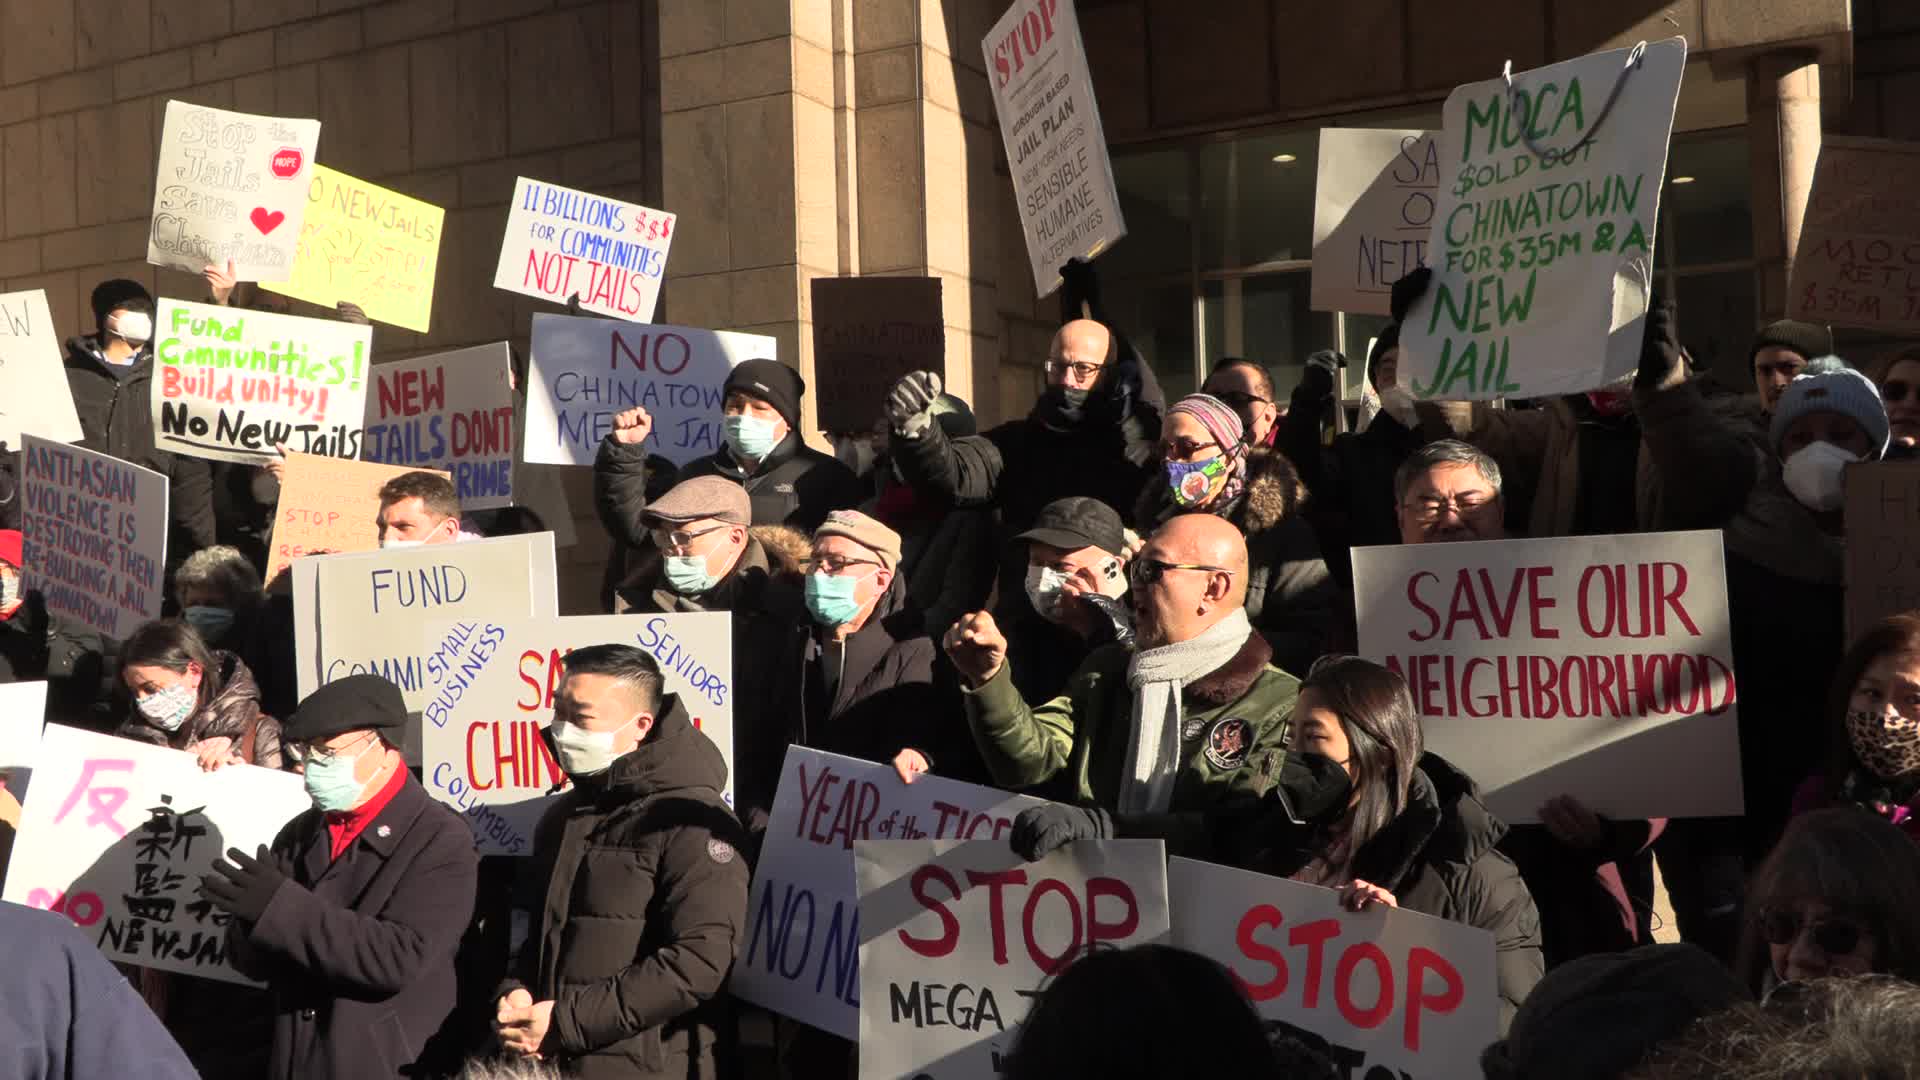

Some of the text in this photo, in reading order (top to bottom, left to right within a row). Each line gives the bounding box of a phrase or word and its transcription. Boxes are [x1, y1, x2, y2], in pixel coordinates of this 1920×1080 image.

[994, 0, 1056, 88] STOP
[179, 111, 257, 154] Stop
[1017, 131, 1041, 165] JAIL
[1041, 95, 1074, 138] PLAN
[1462, 77, 1584, 162] MOCA
[176, 147, 261, 192] Jails
[274, 157, 297, 168] NOPE
[1026, 146, 1088, 216] SENSIBLE
[160, 185, 239, 223] Save
[308, 176, 323, 202] O
[331, 183, 386, 222] NEW
[542, 188, 625, 232] BILLIONS
[1035, 181, 1094, 241] HUMANE
[1445, 173, 1644, 248] CHINATOWN
[530, 222, 662, 278] FOR COMMUNITIES
[1446, 220, 1648, 275] FOR $35M & A
[524, 249, 645, 315] NOT JAILS
[1427, 269, 1537, 336] NEW
[172, 308, 245, 343] Fund
[611, 331, 690, 375] NO
[163, 367, 329, 421] Build unity!
[378, 366, 445, 419] NEW
[554, 372, 722, 410] CHINATOW
[1412, 336, 1520, 397] JAIL
[162, 402, 209, 437] No
[295, 424, 363, 460] Jails
[366, 407, 513, 463] JAILS DONT
[556, 409, 722, 451] ME JAI
[25, 444, 136, 505] ANTI-ASIAN
[27, 483, 136, 544] VIOLENCE IS
[286, 508, 341, 526] STOP
[23, 512, 155, 591] DESTROYING THEN
[40, 579, 118, 635] CHINATOWN
[107, 574, 118, 602] A
[371, 566, 467, 613] FUND
[1407, 561, 1701, 642] SAVE OUR
[426, 623, 505, 729] BUSINESS
[427, 622, 478, 684] SMALL
[517, 648, 573, 711] SA
[636, 618, 728, 706] SENIORS
[1386, 653, 1736, 720] NEIGHBORHOOD
[54, 759, 136, 840] 反
[799, 762, 880, 850] YEAR
[878, 809, 900, 840] of
[26, 887, 104, 926] NO
[747, 879, 815, 980] NO
[898, 864, 1140, 977] STOP
[890, 980, 1006, 1032] MEGA
[1227, 904, 1464, 1053] STOP
